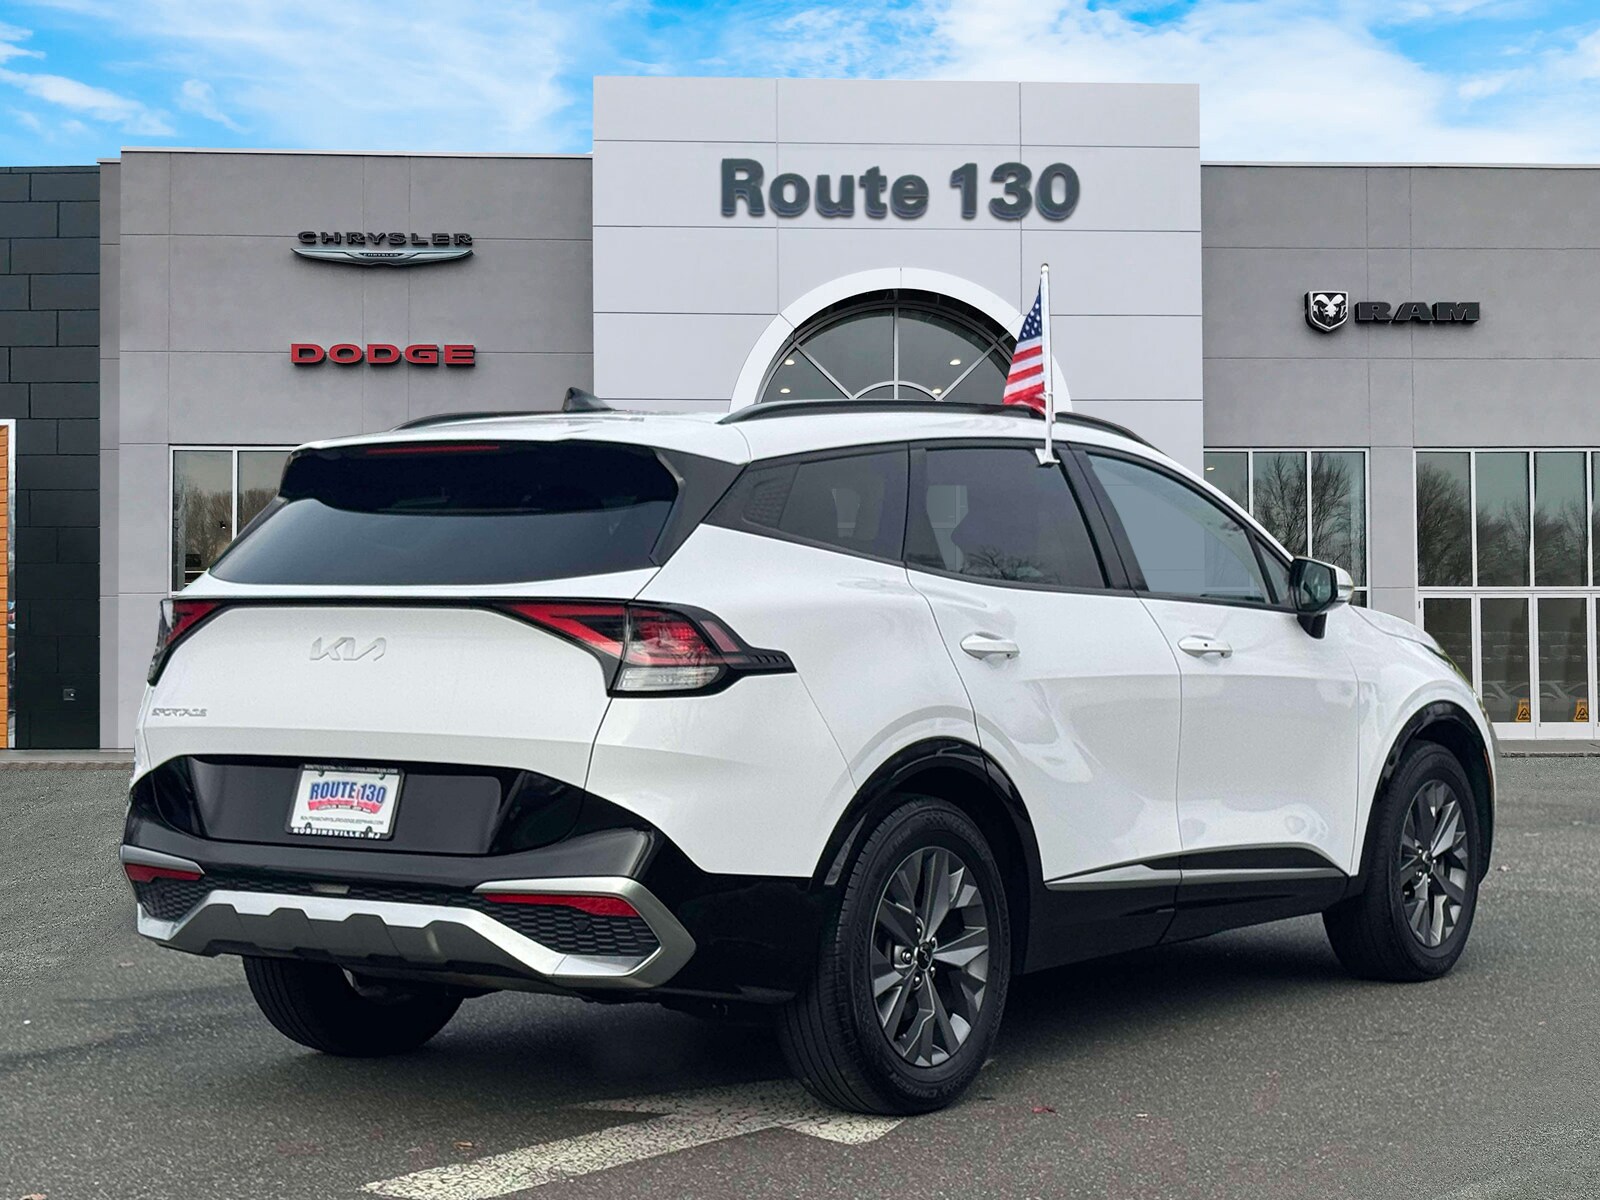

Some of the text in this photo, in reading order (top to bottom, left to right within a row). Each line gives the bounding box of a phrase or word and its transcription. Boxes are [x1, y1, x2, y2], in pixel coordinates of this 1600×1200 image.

[721, 158, 1081, 221] Route 130
[297, 231, 473, 245] CHRYSLER
[1355, 301, 1480, 325] RAM
[290, 343, 476, 367] DODGE
[309, 782, 386, 803] ROUTE 130
[368, 832, 381, 840] NJ
